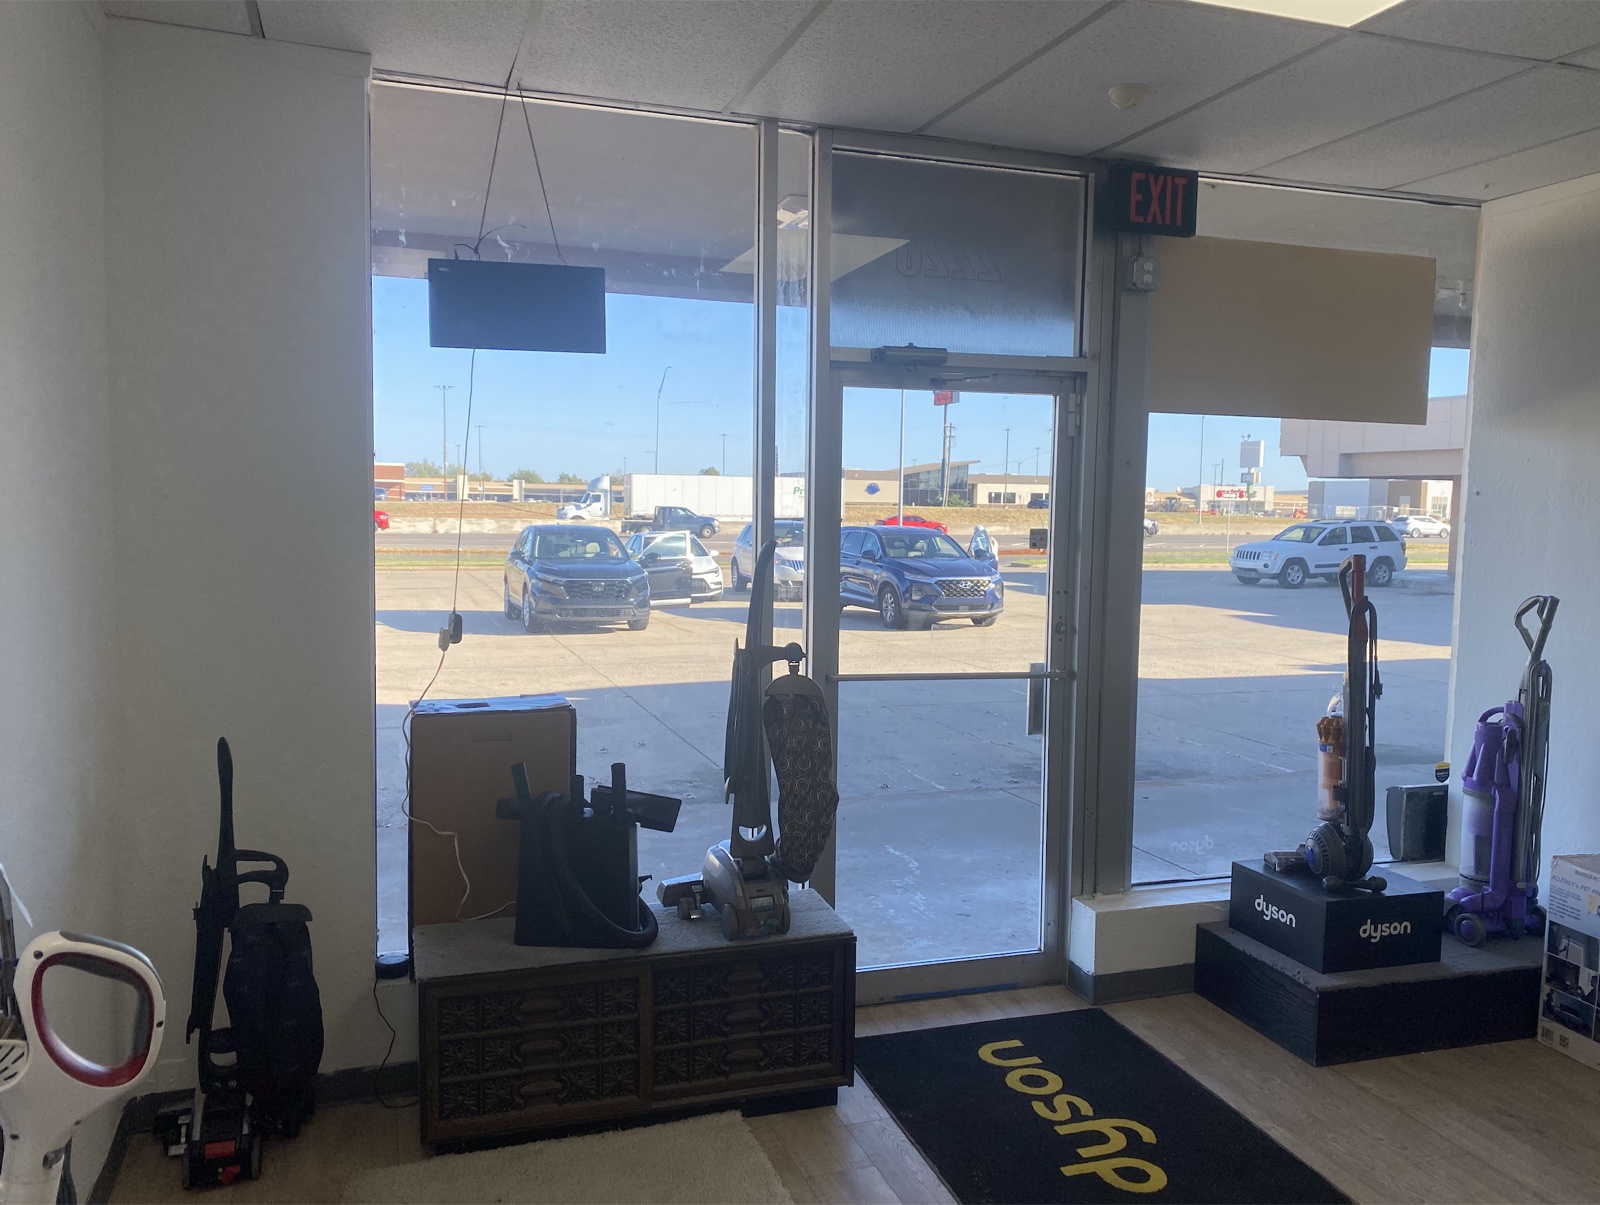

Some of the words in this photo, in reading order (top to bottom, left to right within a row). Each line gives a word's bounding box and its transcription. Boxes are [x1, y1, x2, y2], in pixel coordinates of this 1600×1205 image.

[1130, 172, 1188, 227] EXIT
[1551, 875, 1576, 886] ALLERGY
[1580, 884, 1591, 893] PET
[1254, 894, 1296, 928] dyson
[1359, 919, 1411, 943] dyson
[977, 1039, 1168, 1193] dyson
